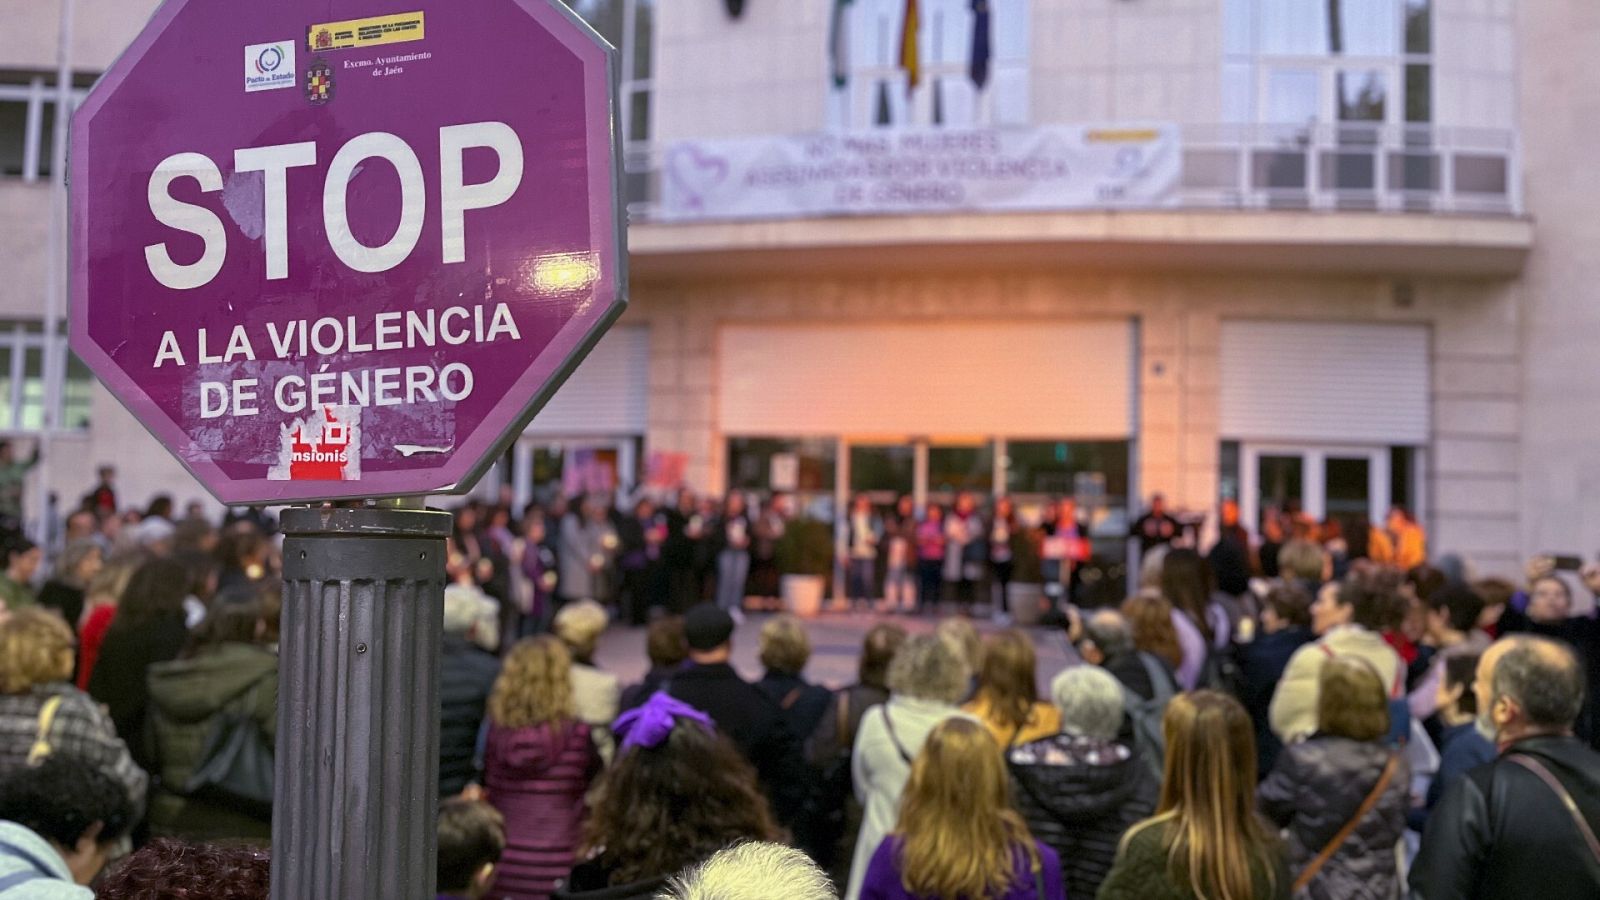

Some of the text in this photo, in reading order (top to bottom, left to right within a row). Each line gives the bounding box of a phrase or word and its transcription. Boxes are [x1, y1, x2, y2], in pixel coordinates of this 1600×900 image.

[246, 76, 265, 84] Pacto
[272, 72, 295, 80] Estado
[344, 52, 432, 69] Excmo. Ayuntamiento
[372, 66, 403, 76] de Jaén
[144, 121, 524, 289] STOP
[153, 303, 521, 368] A LA VIOLENCIA
[200, 364, 474, 418] DE GÉNERO
